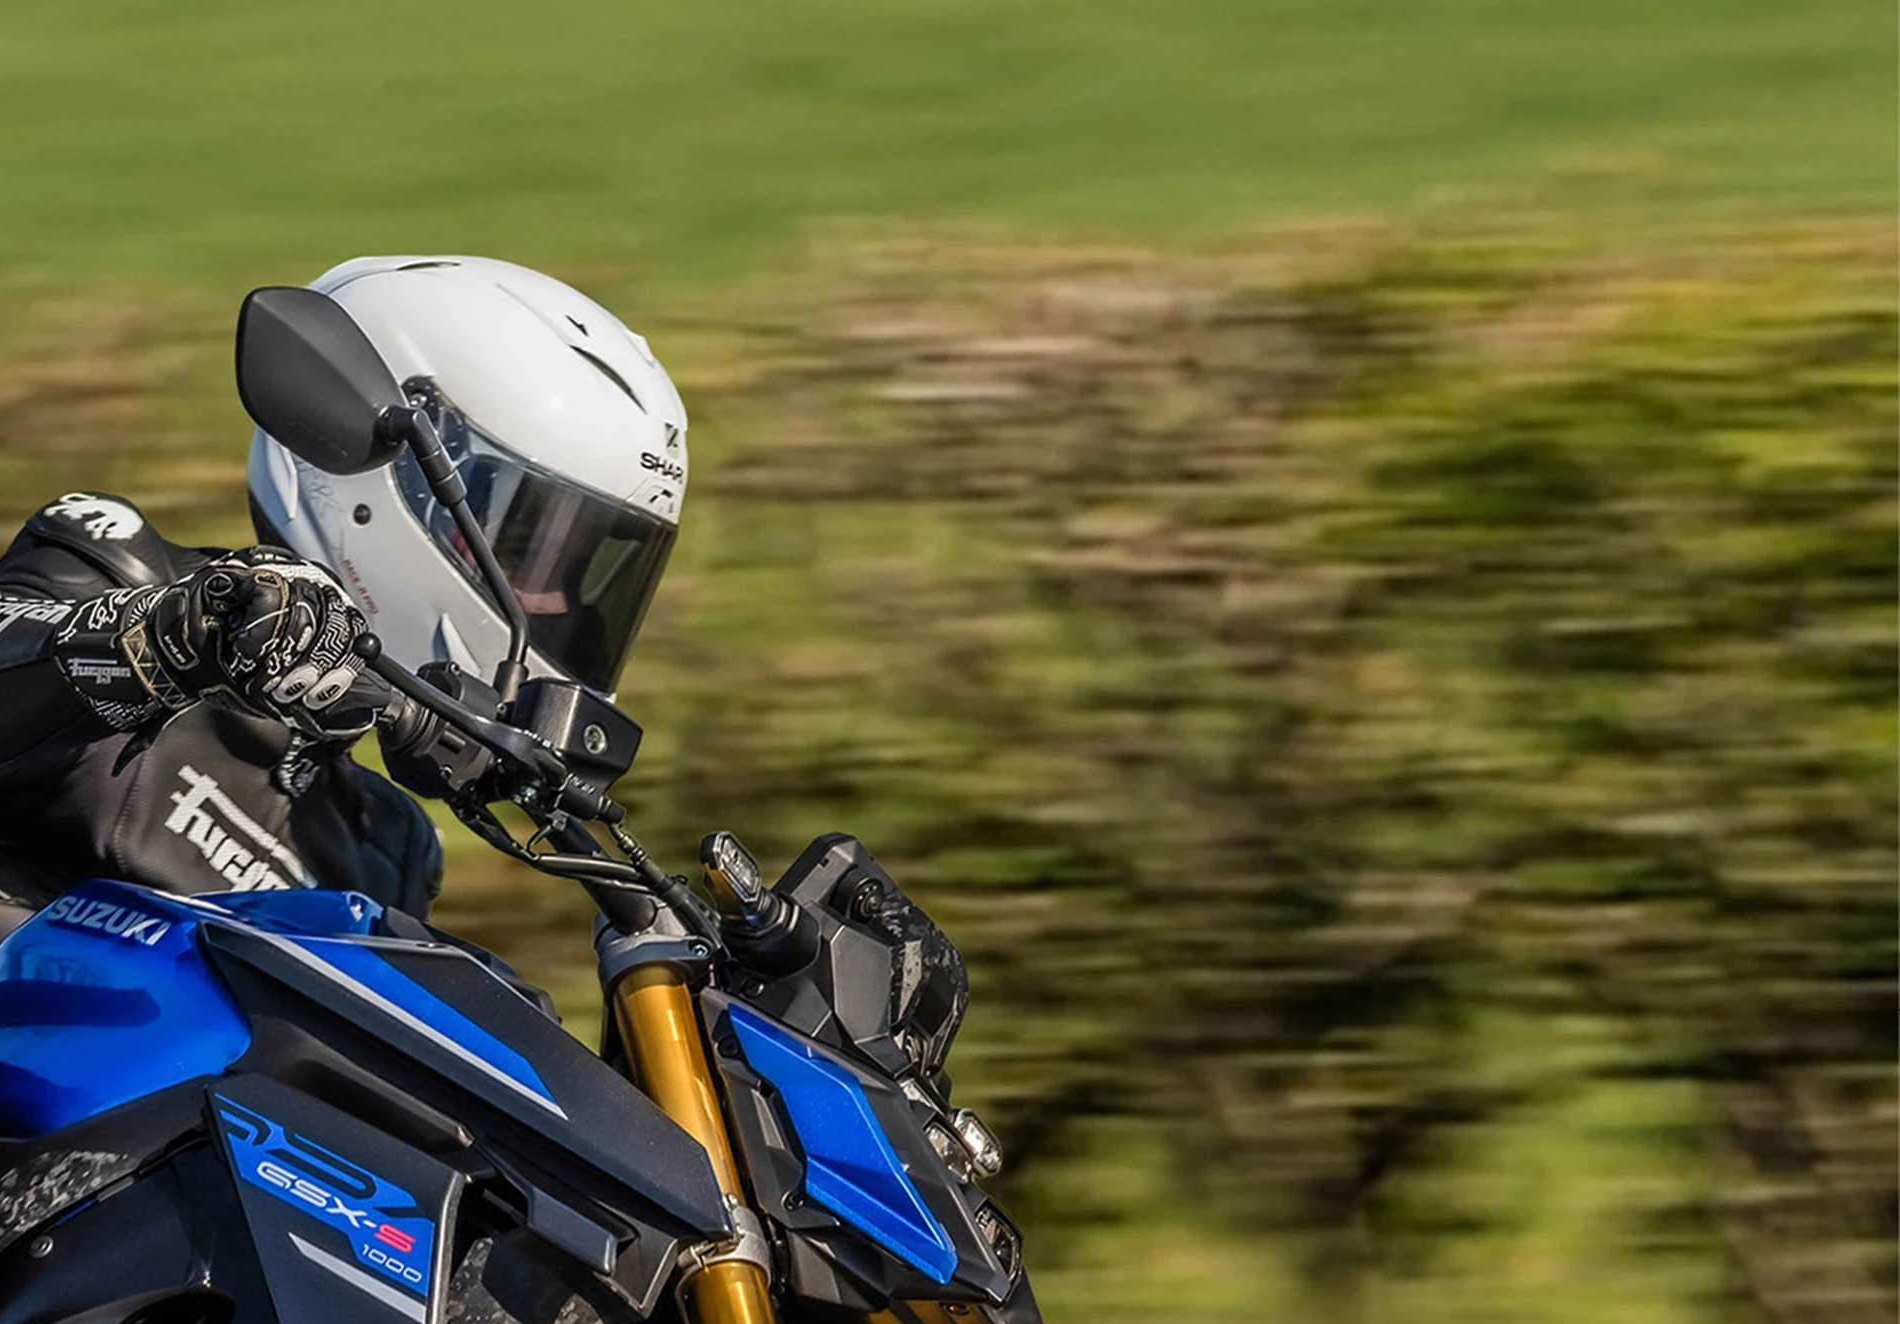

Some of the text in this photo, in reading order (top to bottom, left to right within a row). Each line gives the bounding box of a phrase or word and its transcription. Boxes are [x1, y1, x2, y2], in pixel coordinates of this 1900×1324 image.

[640, 451, 684, 485] SHAR
[163, 764, 319, 892] Fury
[47, 895, 173, 947] SUZUKI
[256, 1160, 417, 1253] GSX-S
[360, 1243, 423, 1284] 1000
